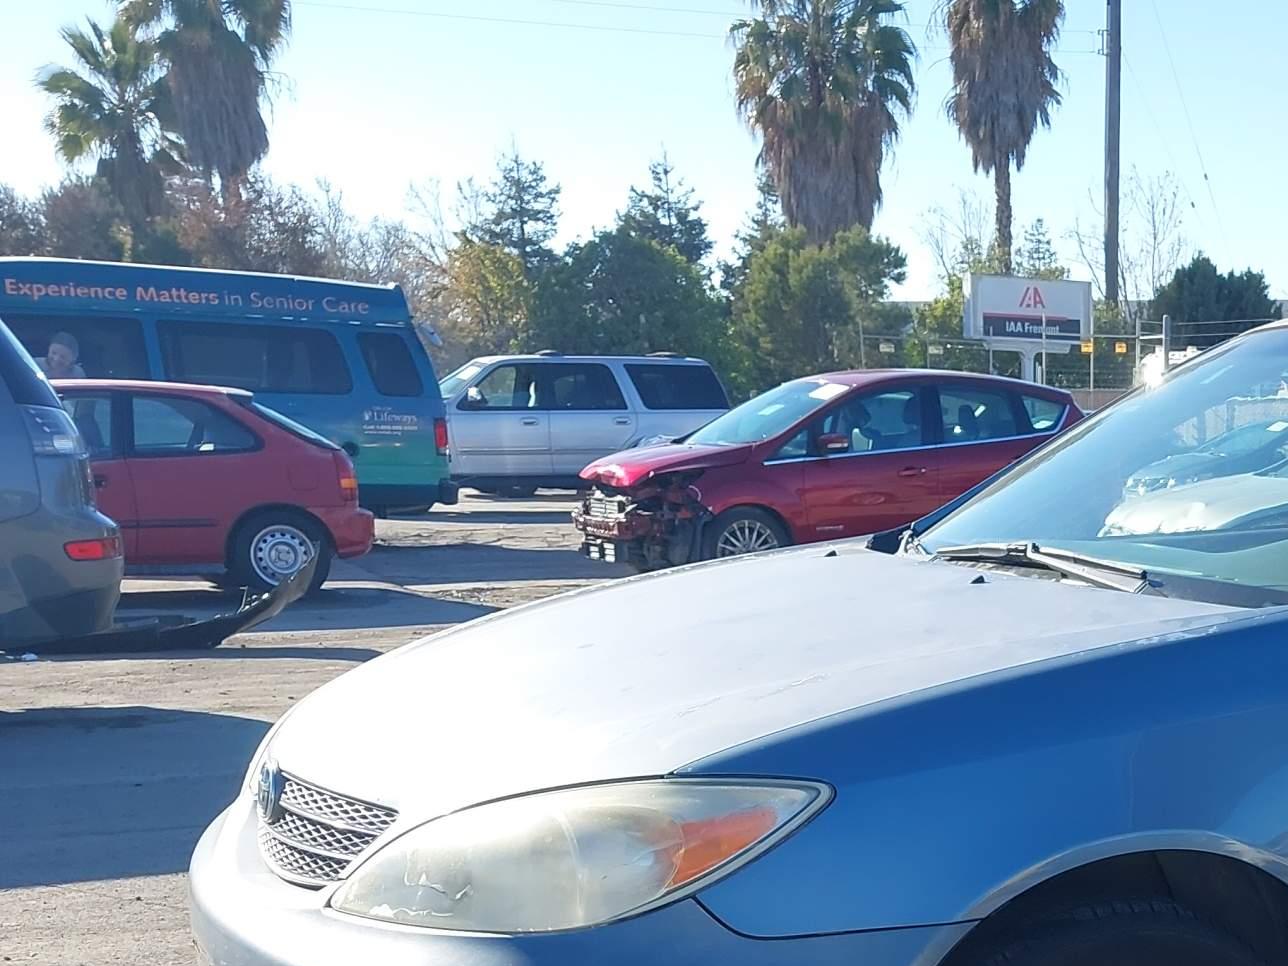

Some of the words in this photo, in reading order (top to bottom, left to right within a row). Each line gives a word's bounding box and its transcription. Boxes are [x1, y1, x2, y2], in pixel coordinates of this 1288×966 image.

[4, 278, 128, 300] Experience
[136, 286, 219, 305] Matters
[224, 290, 242, 306] in
[250, 291, 315, 311] Senior
[322, 296, 369, 314] Care
[1005, 320, 1023, 333] IAA
